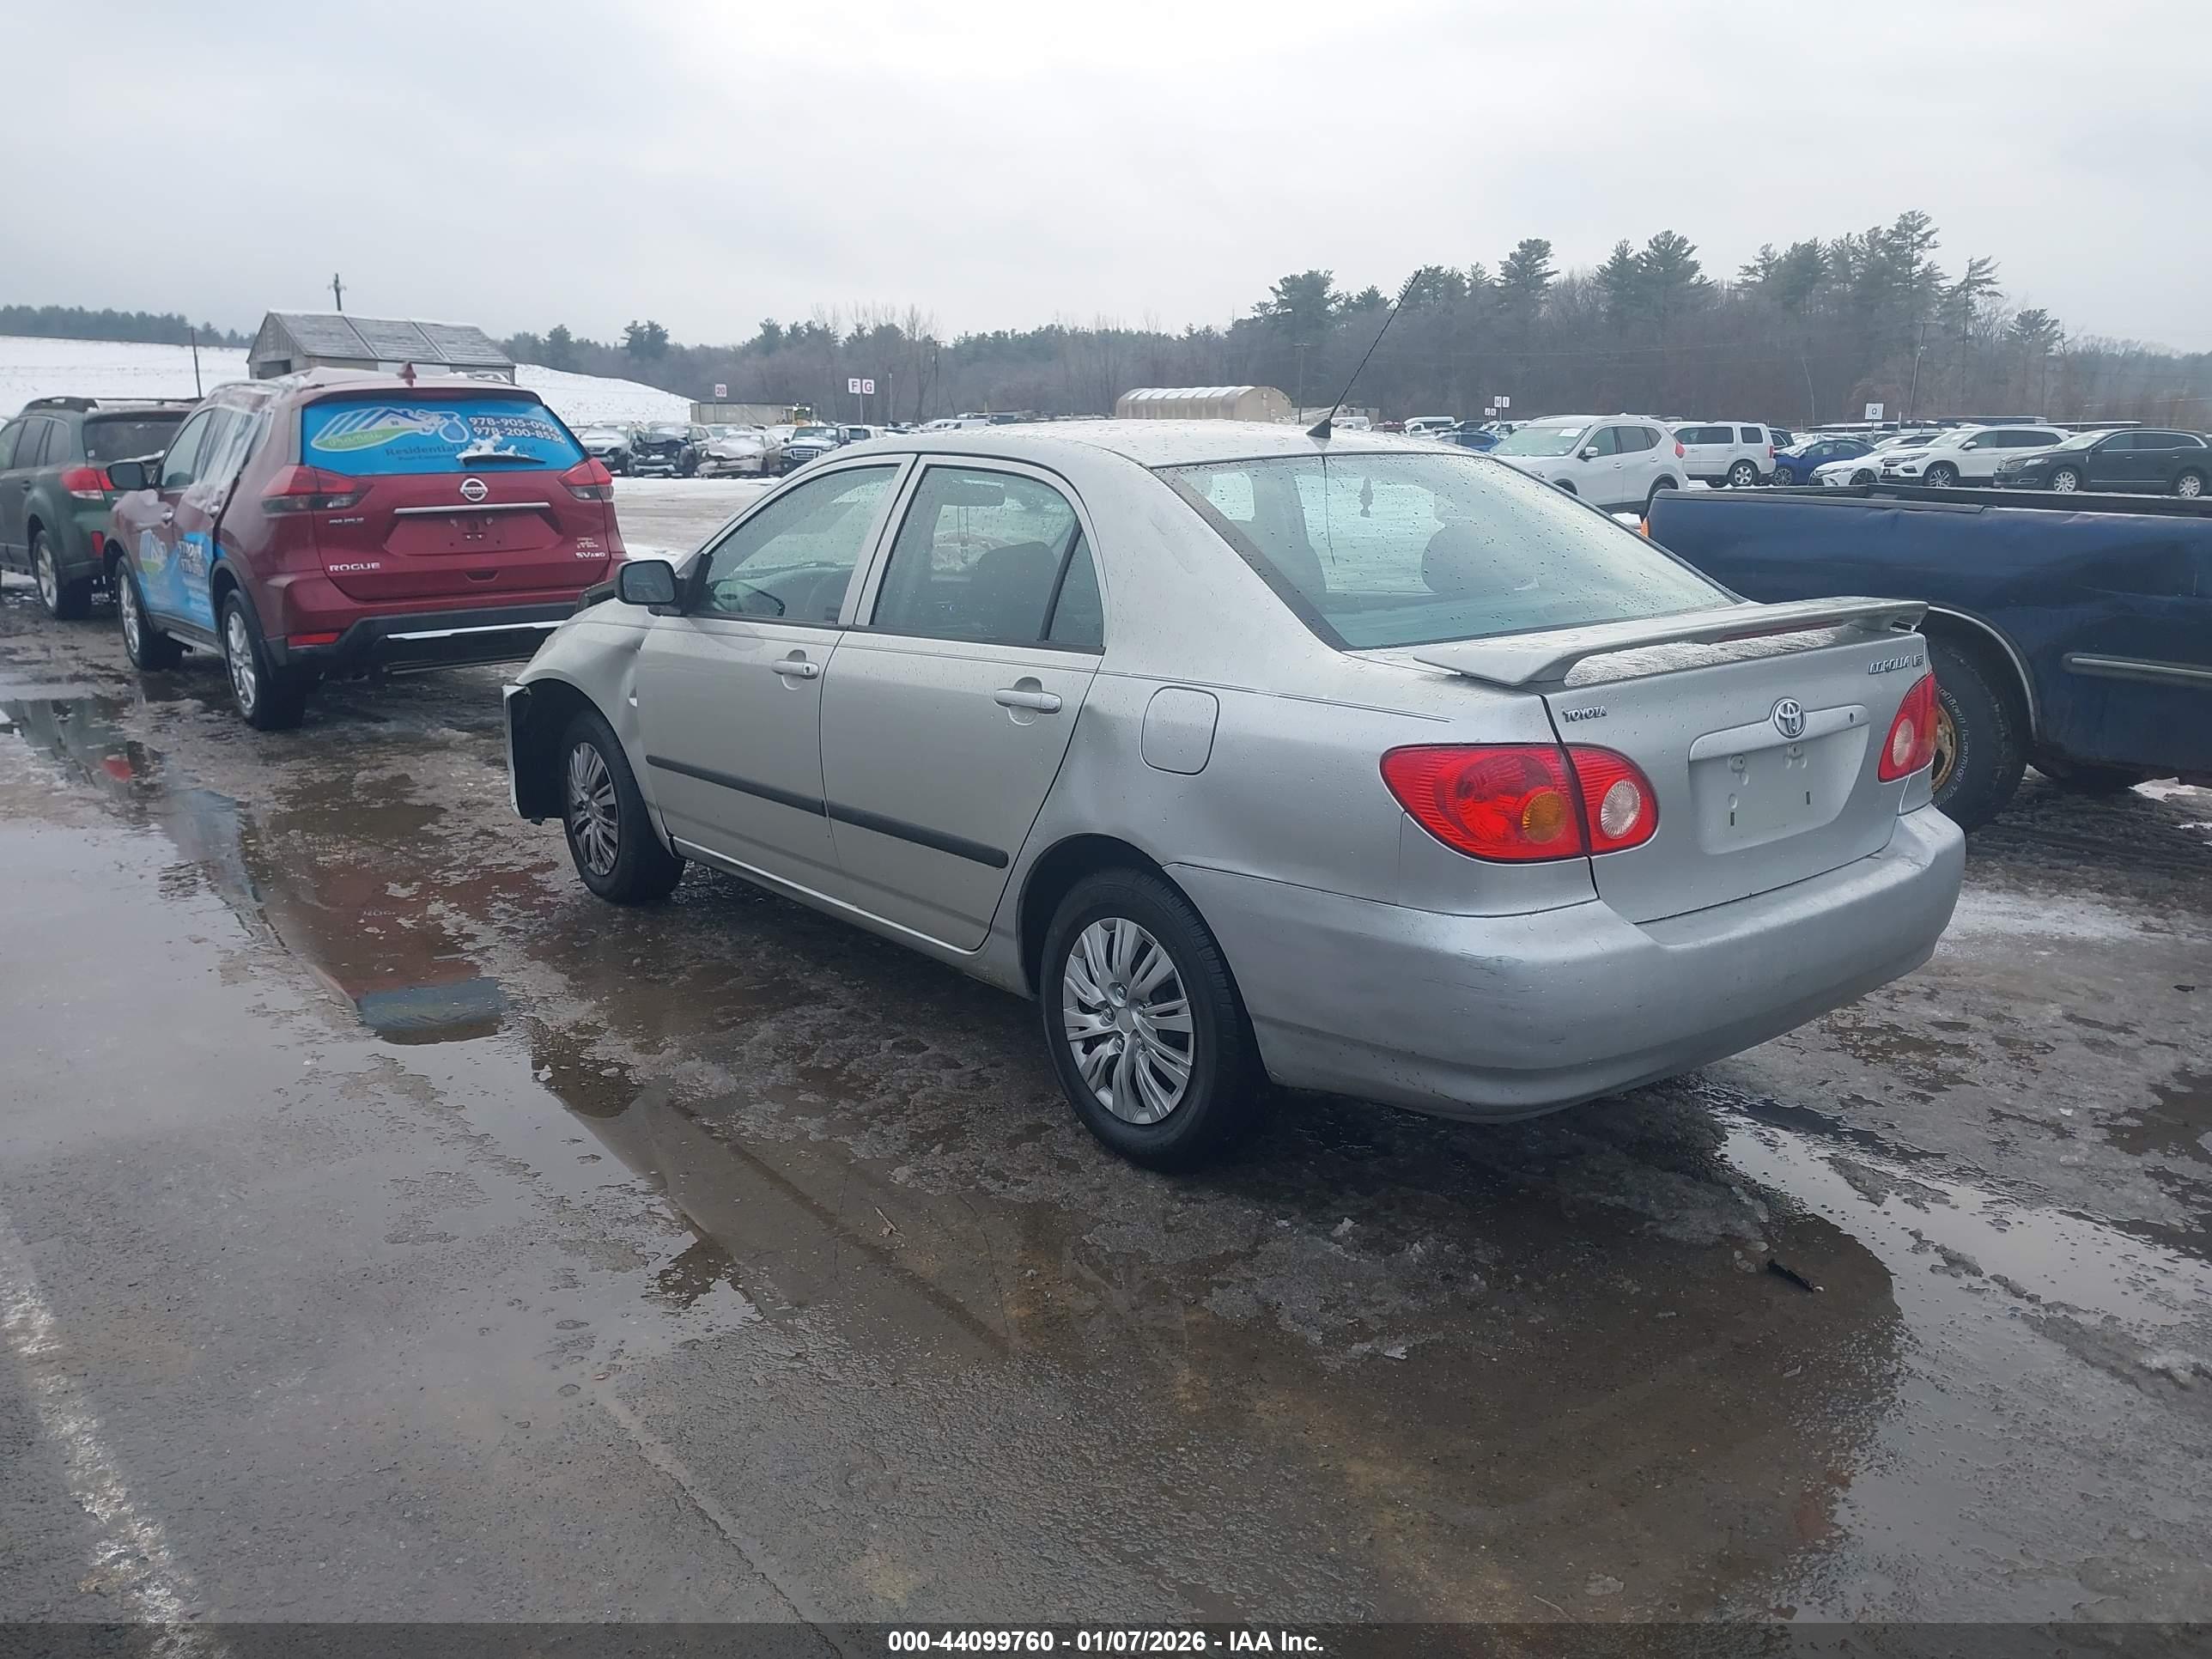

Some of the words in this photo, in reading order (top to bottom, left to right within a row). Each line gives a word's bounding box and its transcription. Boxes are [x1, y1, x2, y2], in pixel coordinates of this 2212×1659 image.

[851, 381, 858, 392] F
[864, 381, 872, 392] G
[385, 445, 456, 457] Residential
[329, 562, 380, 572] ROGUE
[1561, 706, 1608, 722] TOYOTA
